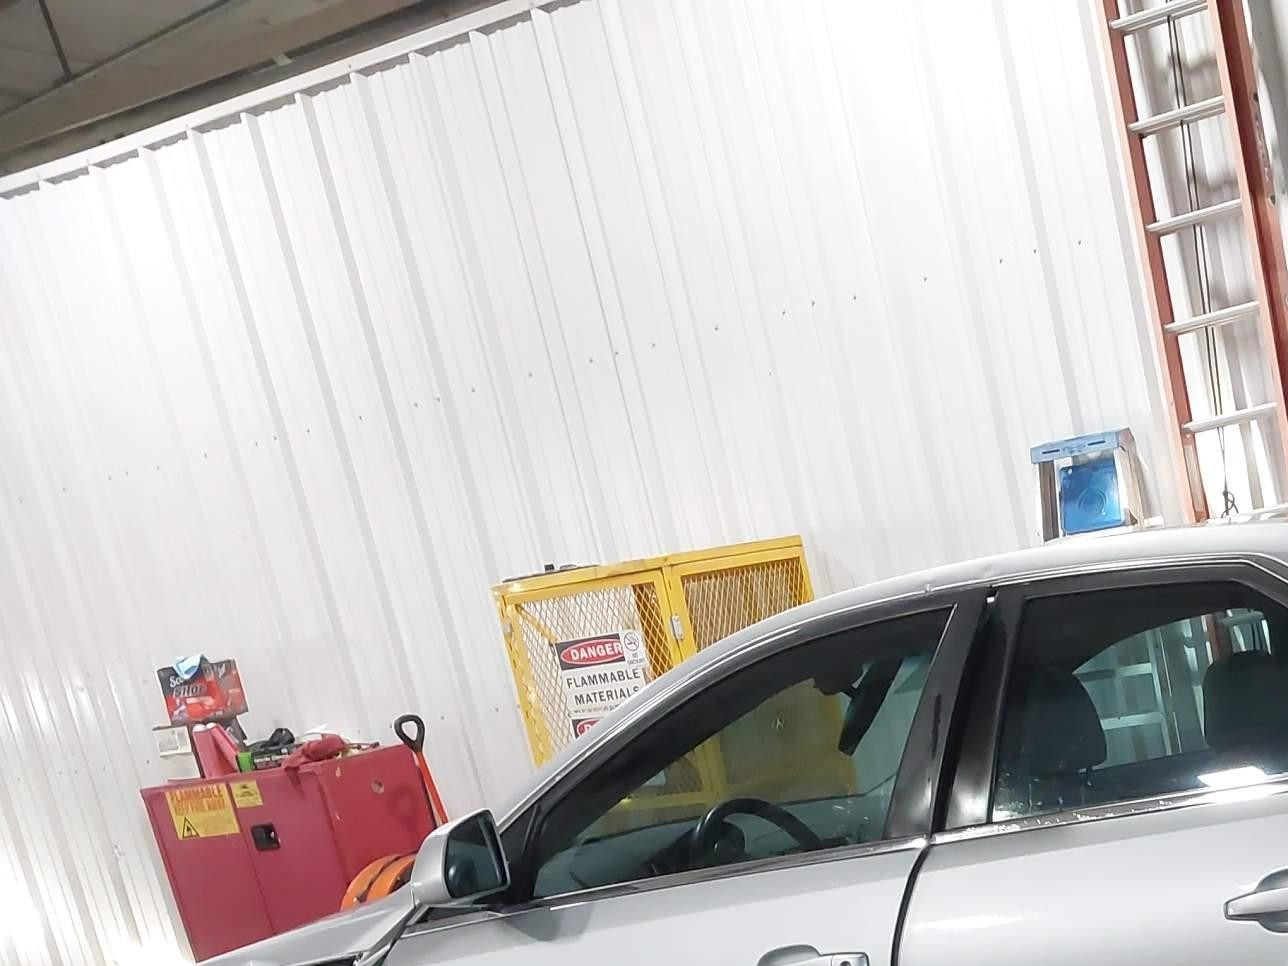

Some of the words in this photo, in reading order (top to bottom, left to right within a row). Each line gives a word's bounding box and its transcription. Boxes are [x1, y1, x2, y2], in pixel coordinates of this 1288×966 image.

[570, 641, 623, 661] DANGER
[566, 668, 641, 689] FLAMMABLE
[574, 685, 640, 706] MATERIALS
